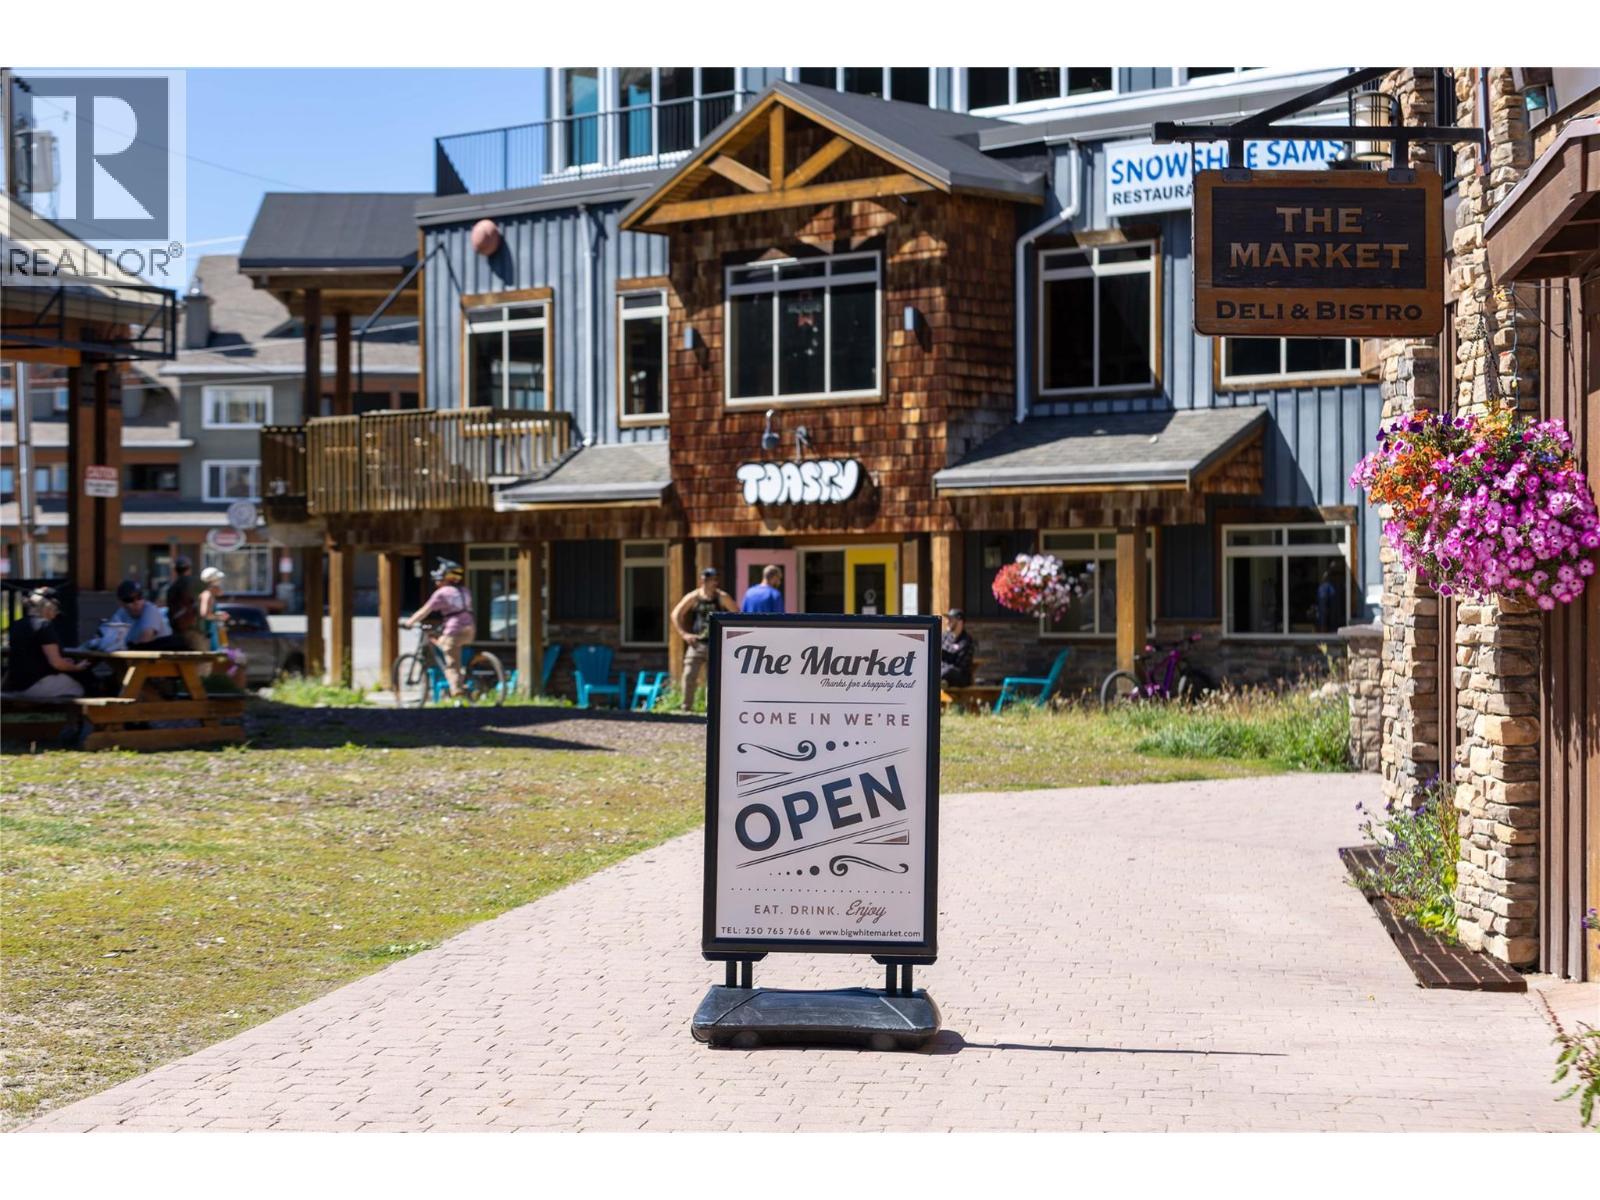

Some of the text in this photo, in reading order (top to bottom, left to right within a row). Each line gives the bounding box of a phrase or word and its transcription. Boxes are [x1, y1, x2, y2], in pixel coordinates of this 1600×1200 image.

[1112, 143, 1258, 185] SNOWSHE
[1276, 207, 1363, 233] THE
[1230, 242, 1409, 269] MARKET
[1216, 300, 1423, 320] DELI & BISTRO
[736, 459, 862, 505] TOASTY
[734, 645, 916, 676] The Market
[845, 680, 861, 692] for
[861, 680, 895, 692] shopping
[739, 711, 911, 727] COME IN WE'RE
[735, 765, 906, 851] OPEN
[754, 900, 887, 923] EAT. DRINK. Enjoy
[721, 926, 921, 938] TEL: 250 765 7666 www.bigwhitemarket.com
